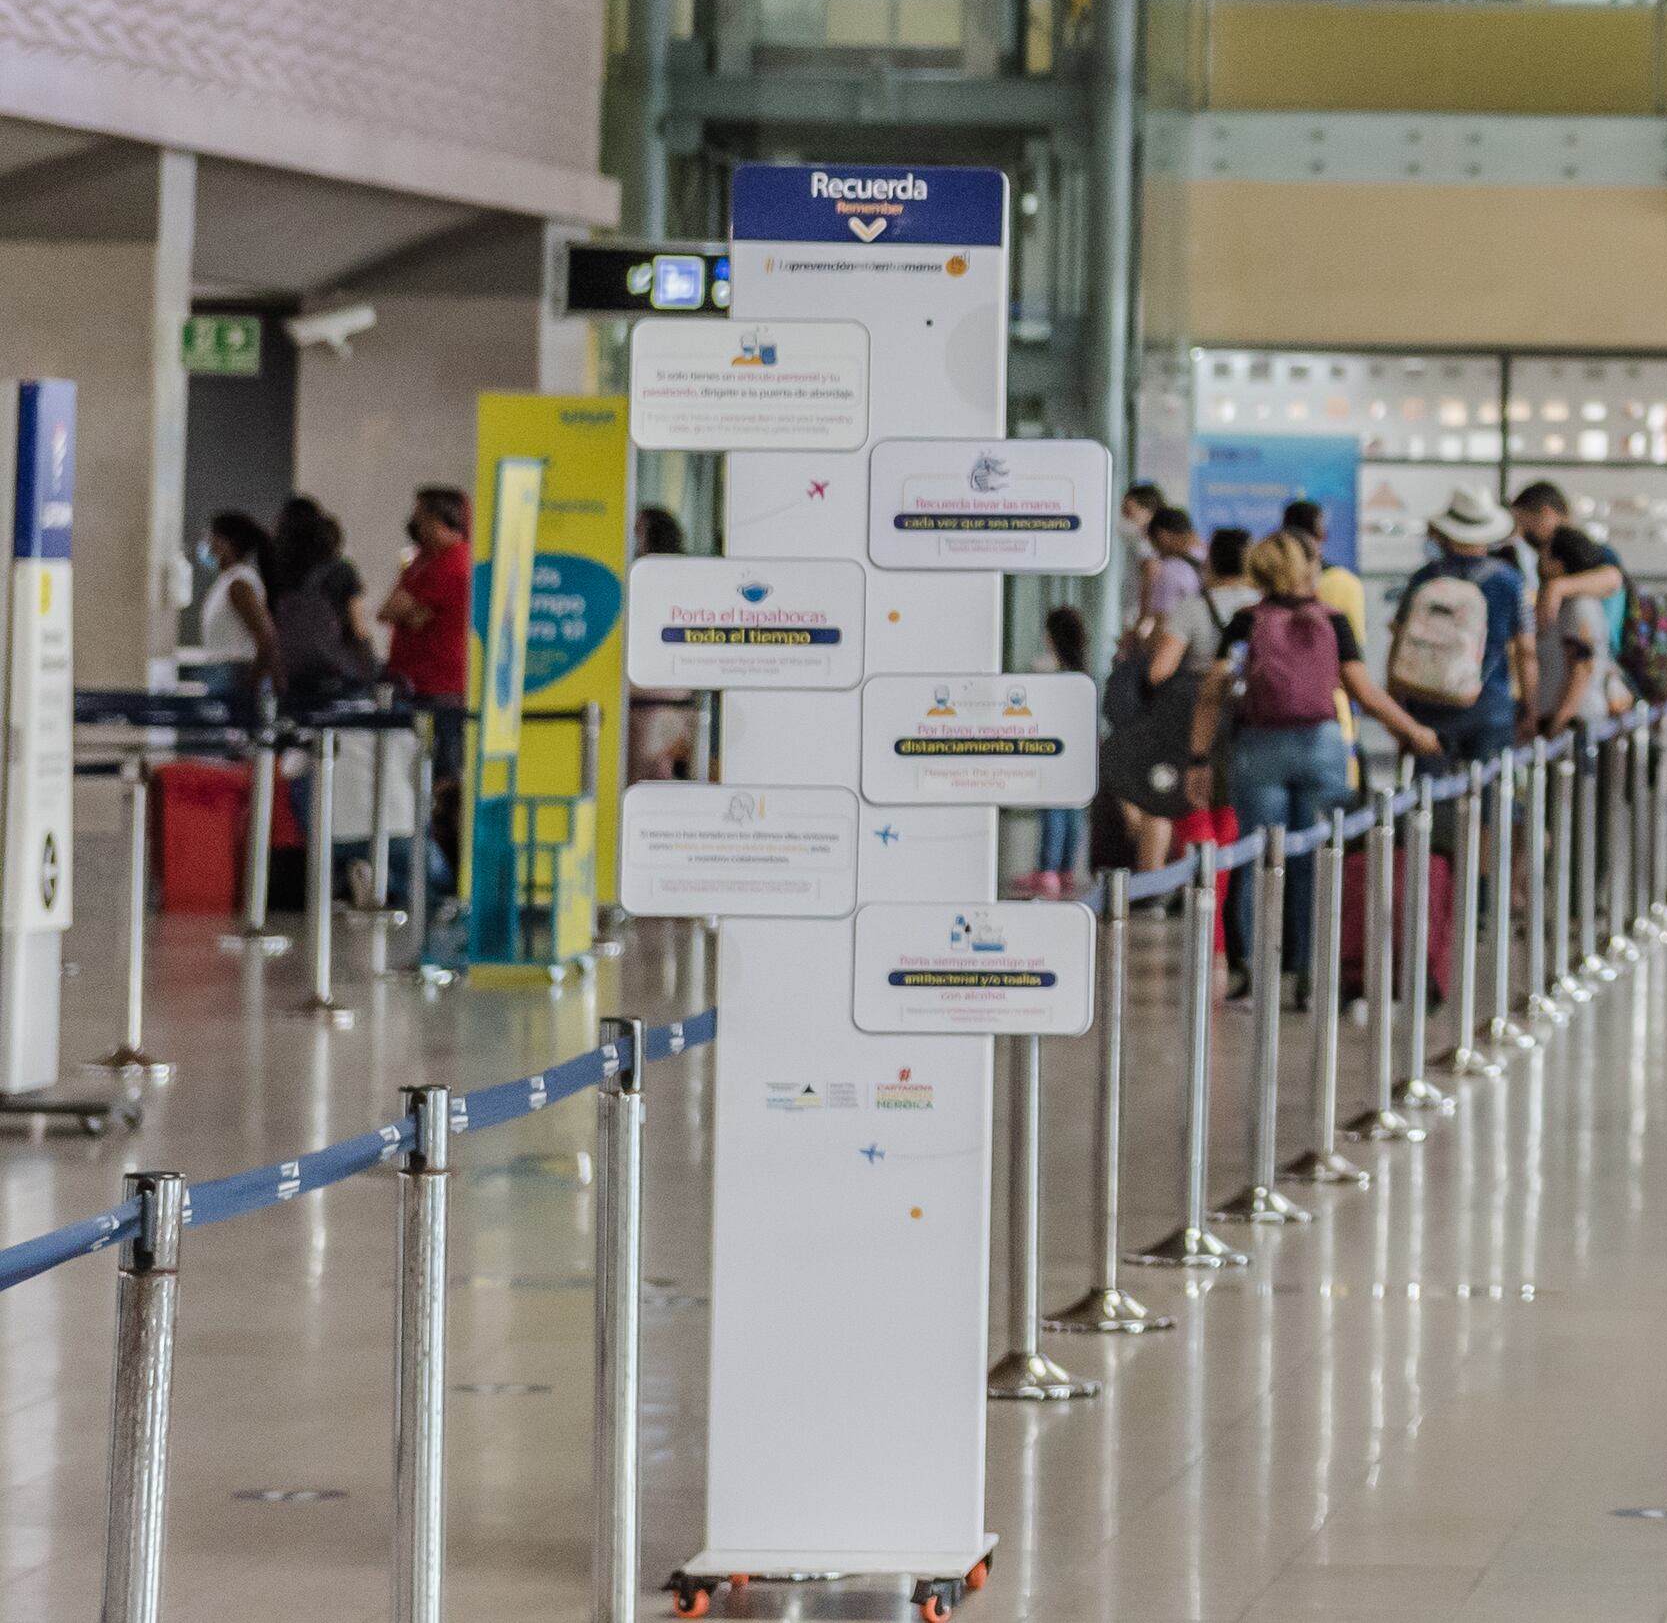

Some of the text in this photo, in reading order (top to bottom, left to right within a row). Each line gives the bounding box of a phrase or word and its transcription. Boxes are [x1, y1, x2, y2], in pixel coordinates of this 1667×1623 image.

[810, 171, 927, 200] Recuerda
[671, 606, 827, 627] Porta el tapabocas
[685, 628, 811, 646] todo el tiempo
[901, 740, 1014, 753] distanciamiento
